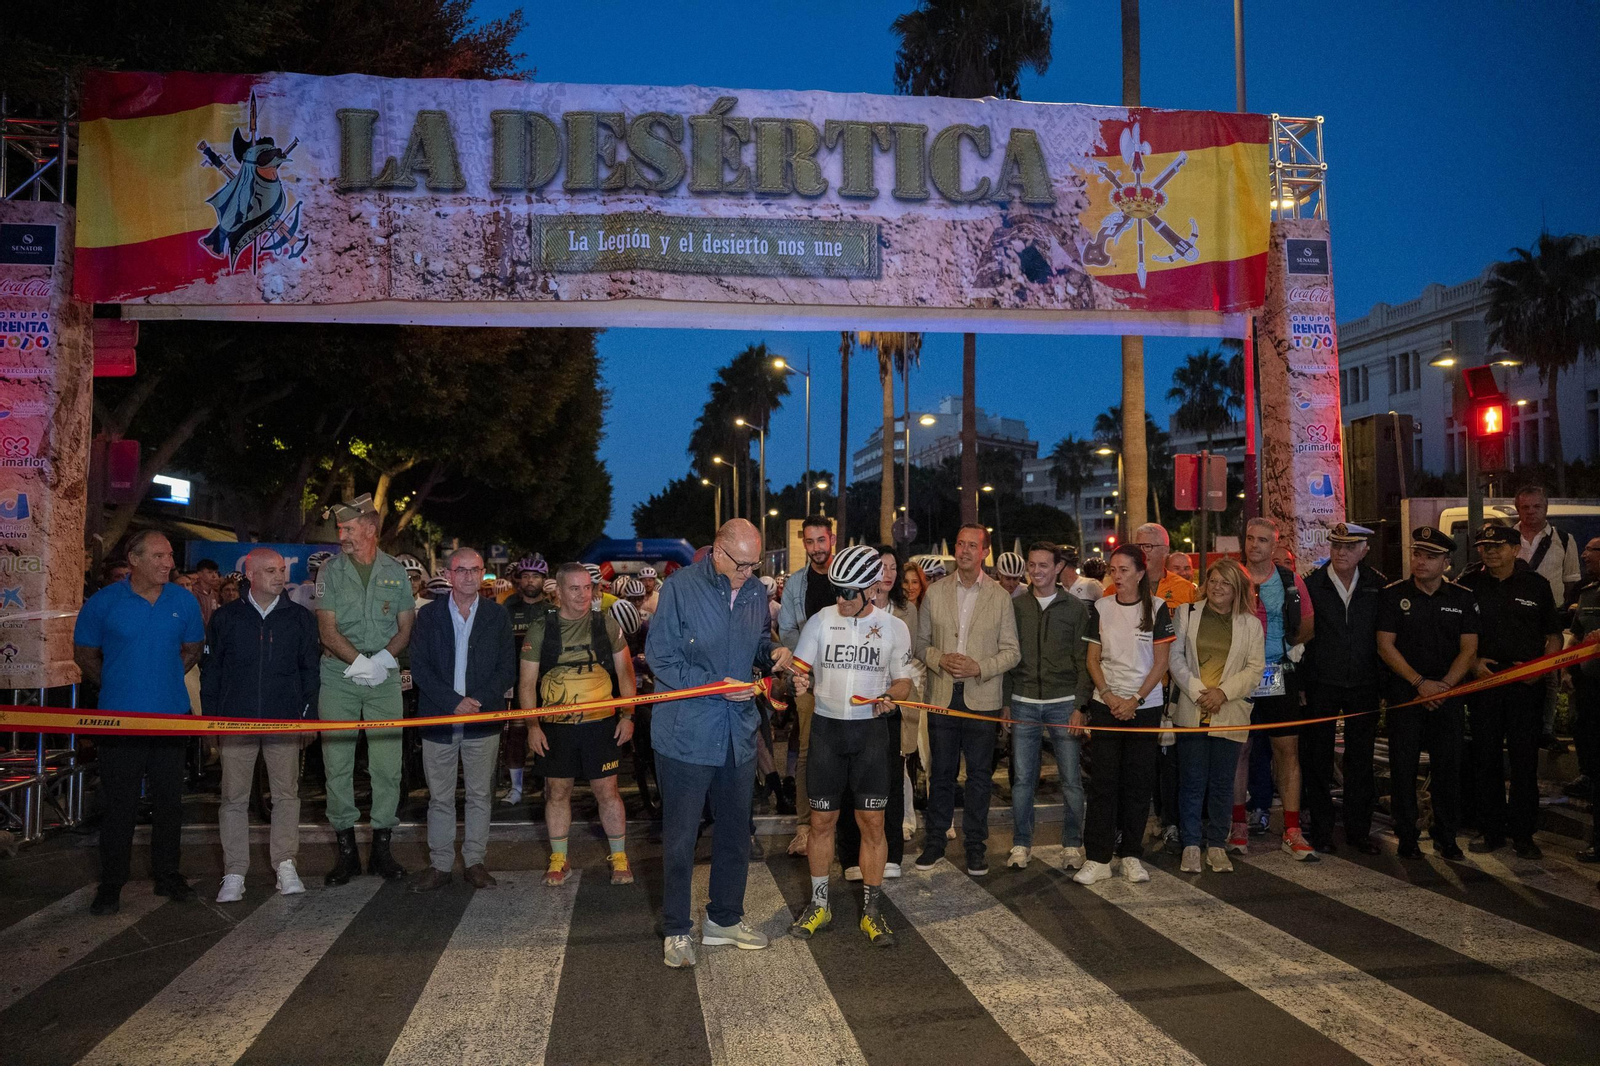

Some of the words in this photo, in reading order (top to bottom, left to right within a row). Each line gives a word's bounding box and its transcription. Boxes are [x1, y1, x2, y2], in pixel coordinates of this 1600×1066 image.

[336, 108, 467, 190] LA
[489, 97, 1057, 204] DESÉRTICA
[568, 230, 589, 251] La
[598, 227, 651, 254] Legión
[659, 235, 670, 255] y
[679, 232, 694, 253] el
[702, 233, 769, 255] desierto
[777, 240, 805, 256] nos
[814, 241, 843, 257] une
[0, 321, 49, 333] RENTA
[1293, 324, 1332, 334] RENTA
[1293, 335, 1333, 349] TODO
[1298, 443, 1339, 452] primaflor
[825, 641, 881, 667] LEGIÓN
[76, 718, 121, 727] ALMERÍA
[602, 759, 619, 772] ARMY
